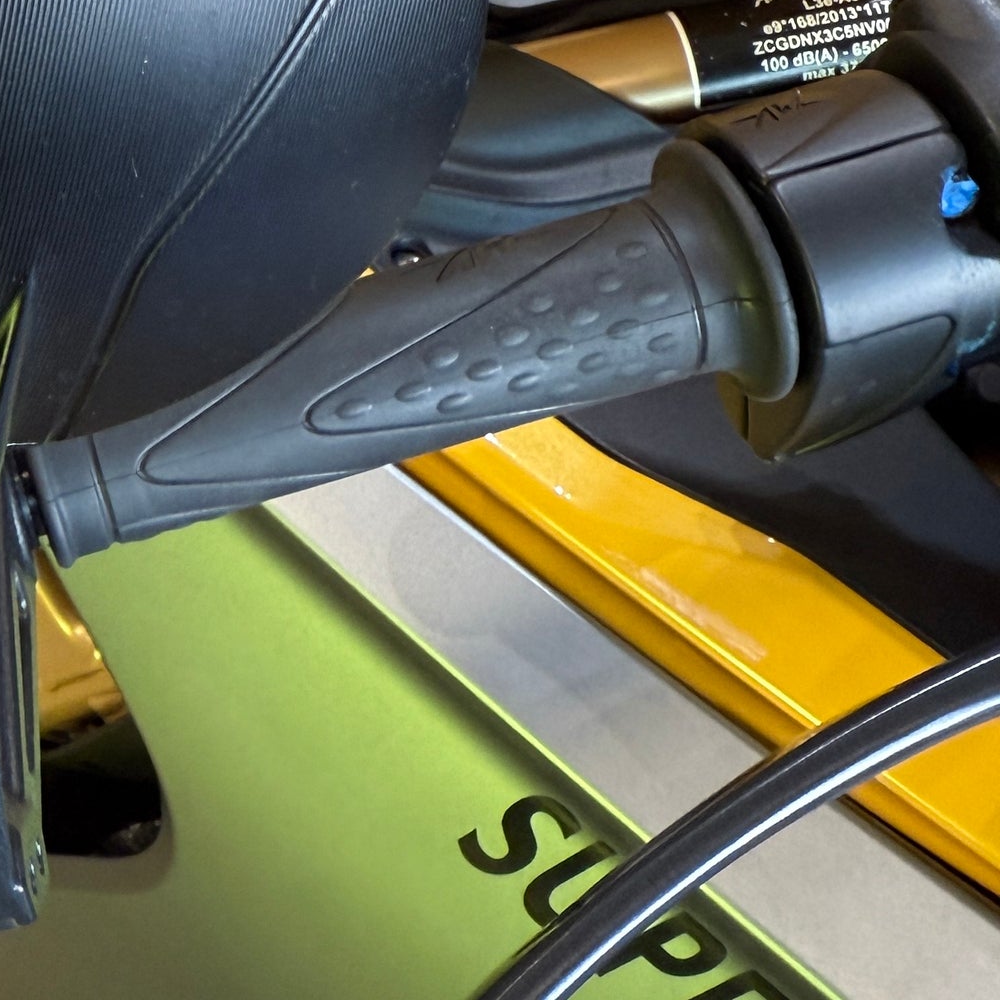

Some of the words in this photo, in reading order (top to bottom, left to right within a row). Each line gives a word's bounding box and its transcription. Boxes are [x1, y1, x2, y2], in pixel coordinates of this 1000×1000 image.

[760, 55, 789, 73] 100
[792, 46, 839, 67] dB(A)
[802, 67, 836, 81] max
